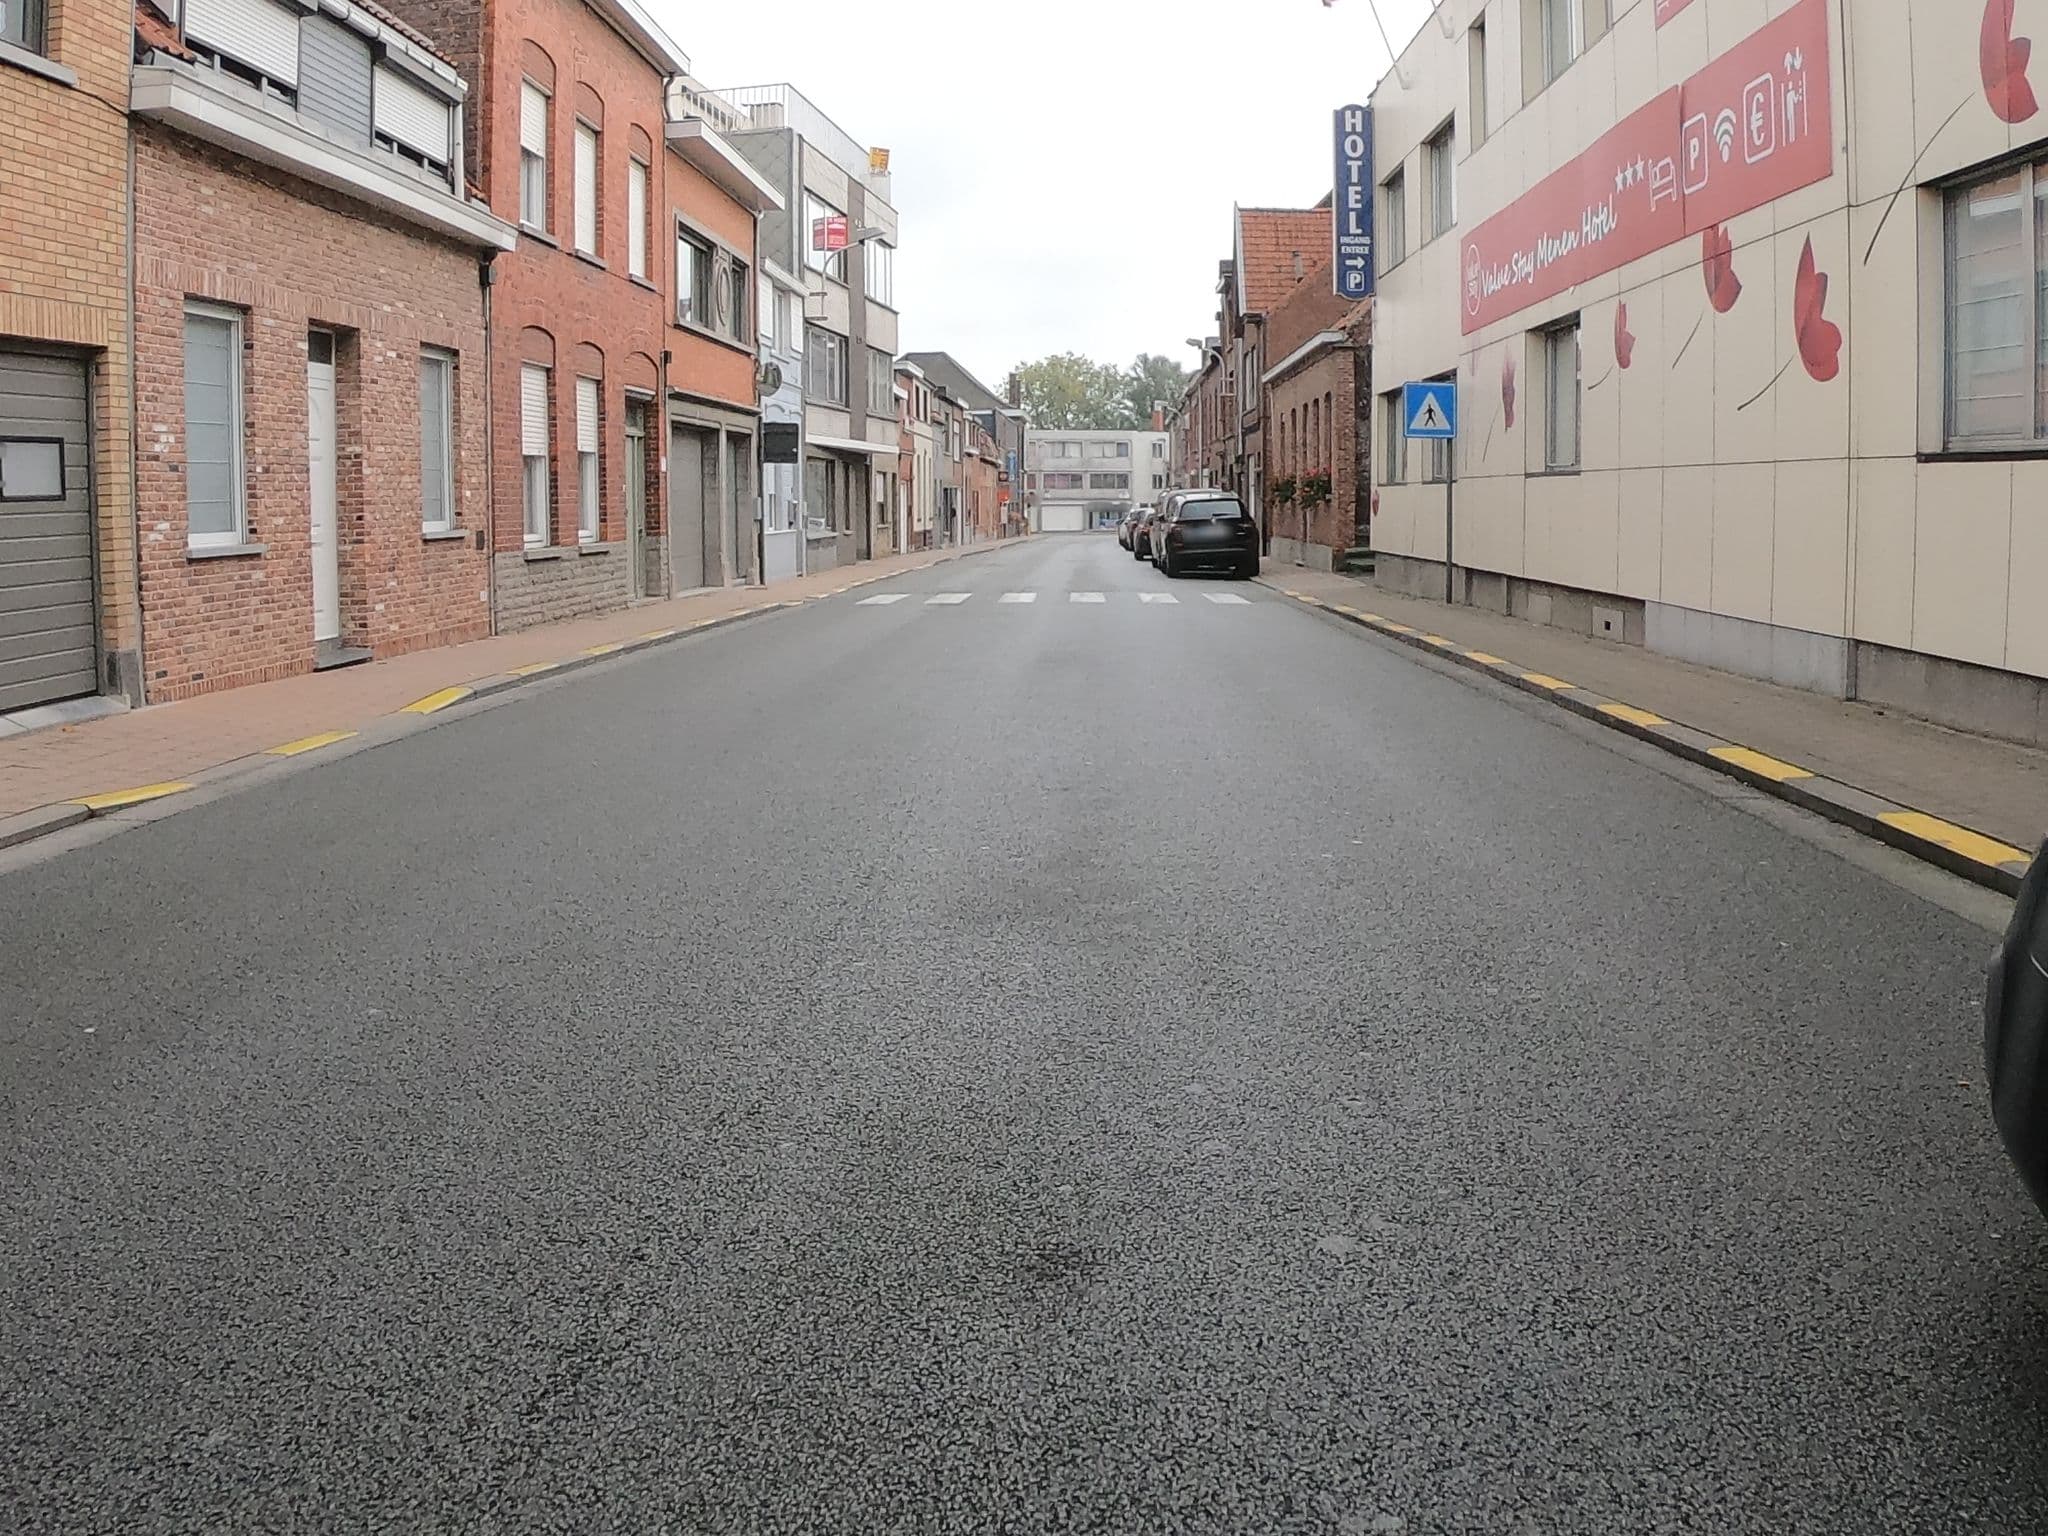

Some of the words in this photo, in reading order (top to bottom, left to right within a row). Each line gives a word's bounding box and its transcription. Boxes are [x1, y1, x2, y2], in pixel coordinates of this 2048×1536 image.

[1344, 110, 1365, 234] HOTEL
[1689, 137, 1700, 171] P
[1481, 262, 1511, 298] Value
[1512, 250, 1534, 284] Stay
[1537, 231, 1580, 270] Menen
[1582, 193, 1618, 248] Hotel
[1350, 273, 1361, 289] P
